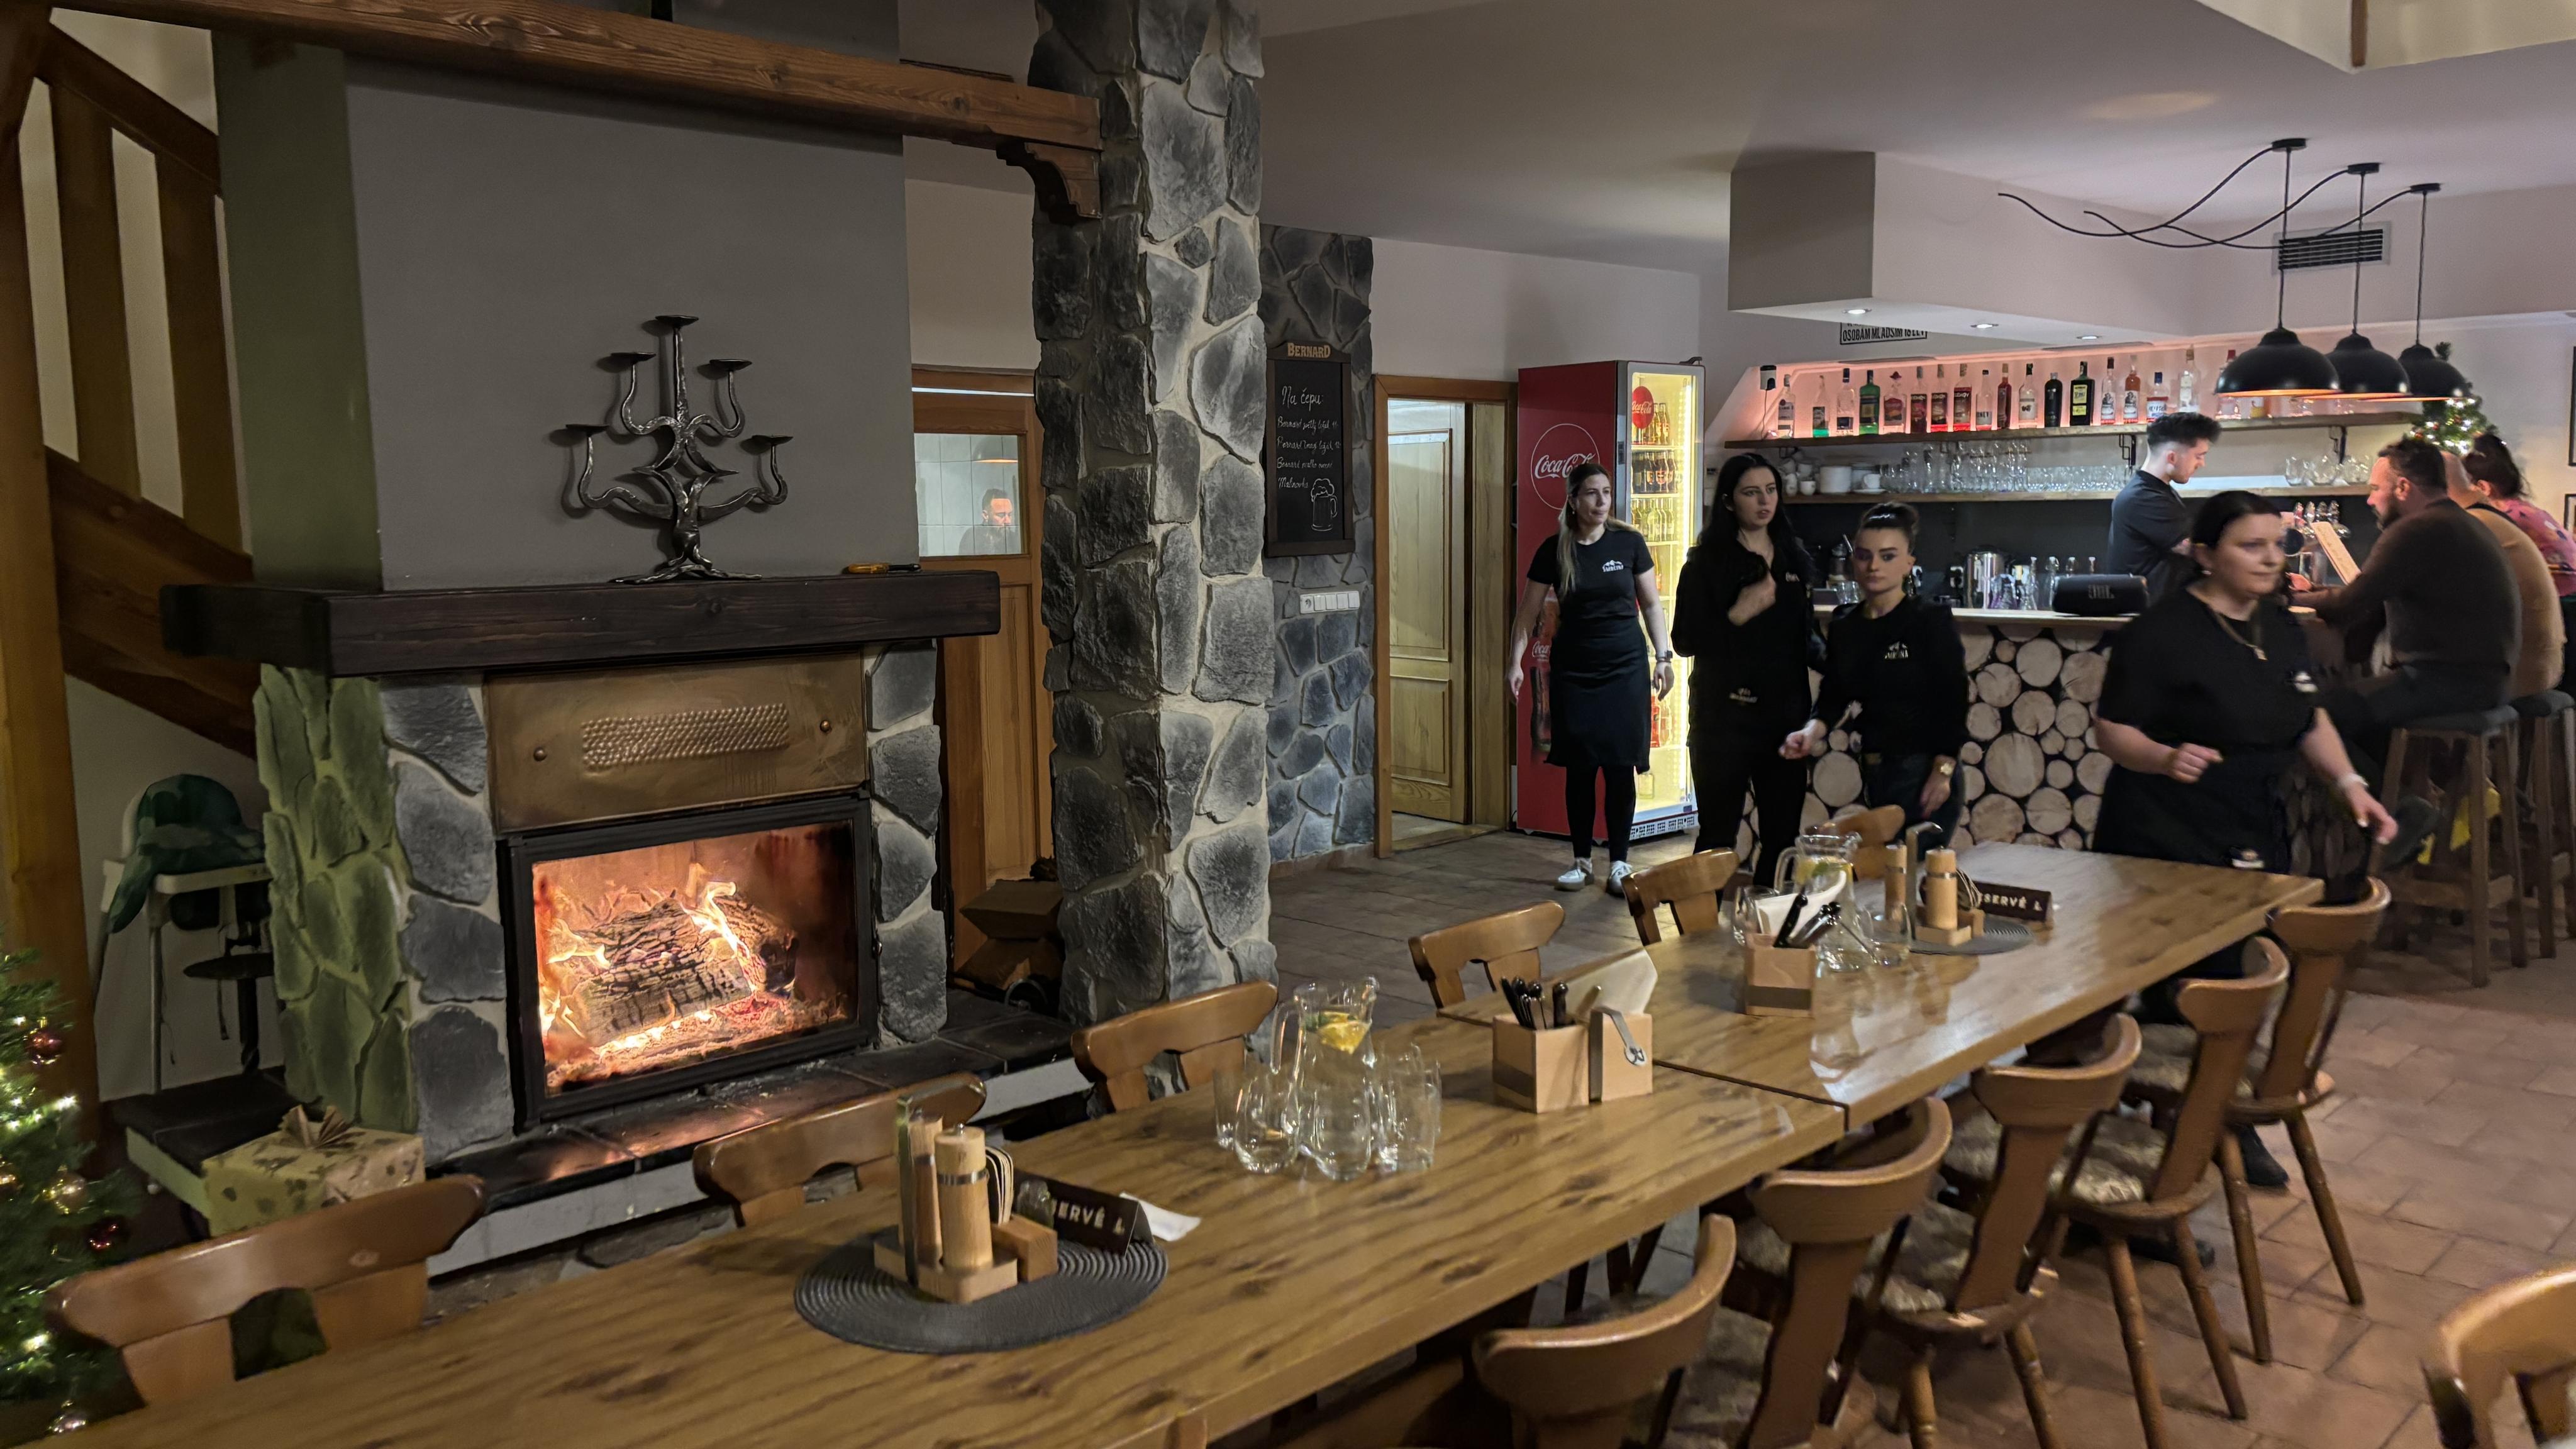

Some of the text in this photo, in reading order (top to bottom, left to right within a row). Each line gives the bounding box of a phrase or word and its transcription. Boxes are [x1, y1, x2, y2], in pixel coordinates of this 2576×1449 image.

[1843, 328, 1870, 341] OSOBAM
[1288, 342, 1331, 358] BERNARD
[1282, 386, 1297, 409] Na
[2088, 584, 2115, 599] JBL
[1978, 892, 2026, 909] SERVÉ
